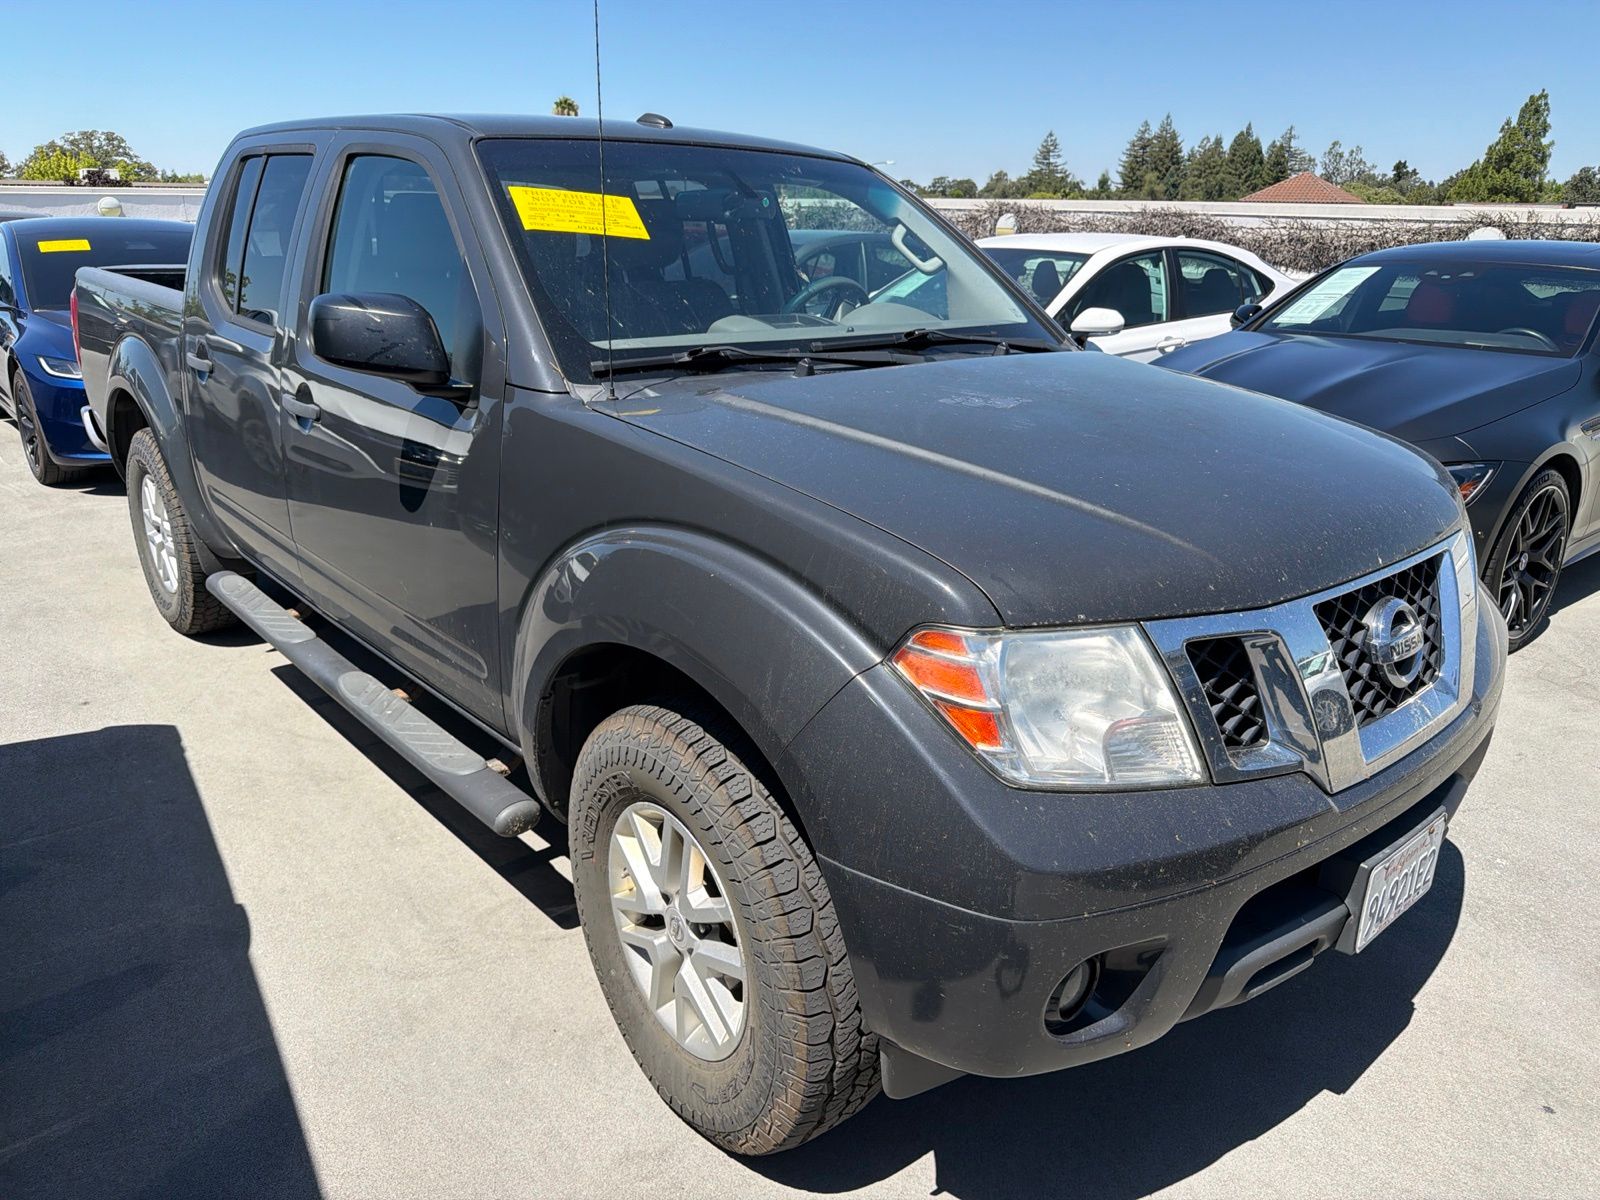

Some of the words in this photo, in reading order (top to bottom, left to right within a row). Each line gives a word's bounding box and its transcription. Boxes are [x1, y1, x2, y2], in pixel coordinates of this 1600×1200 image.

[522, 189, 551, 197] THIS
[562, 198, 585, 206] FOR
[589, 201, 619, 210] SALE
[1390, 632, 1422, 658] NISSA
[1363, 846, 1437, 940] 94921E2
